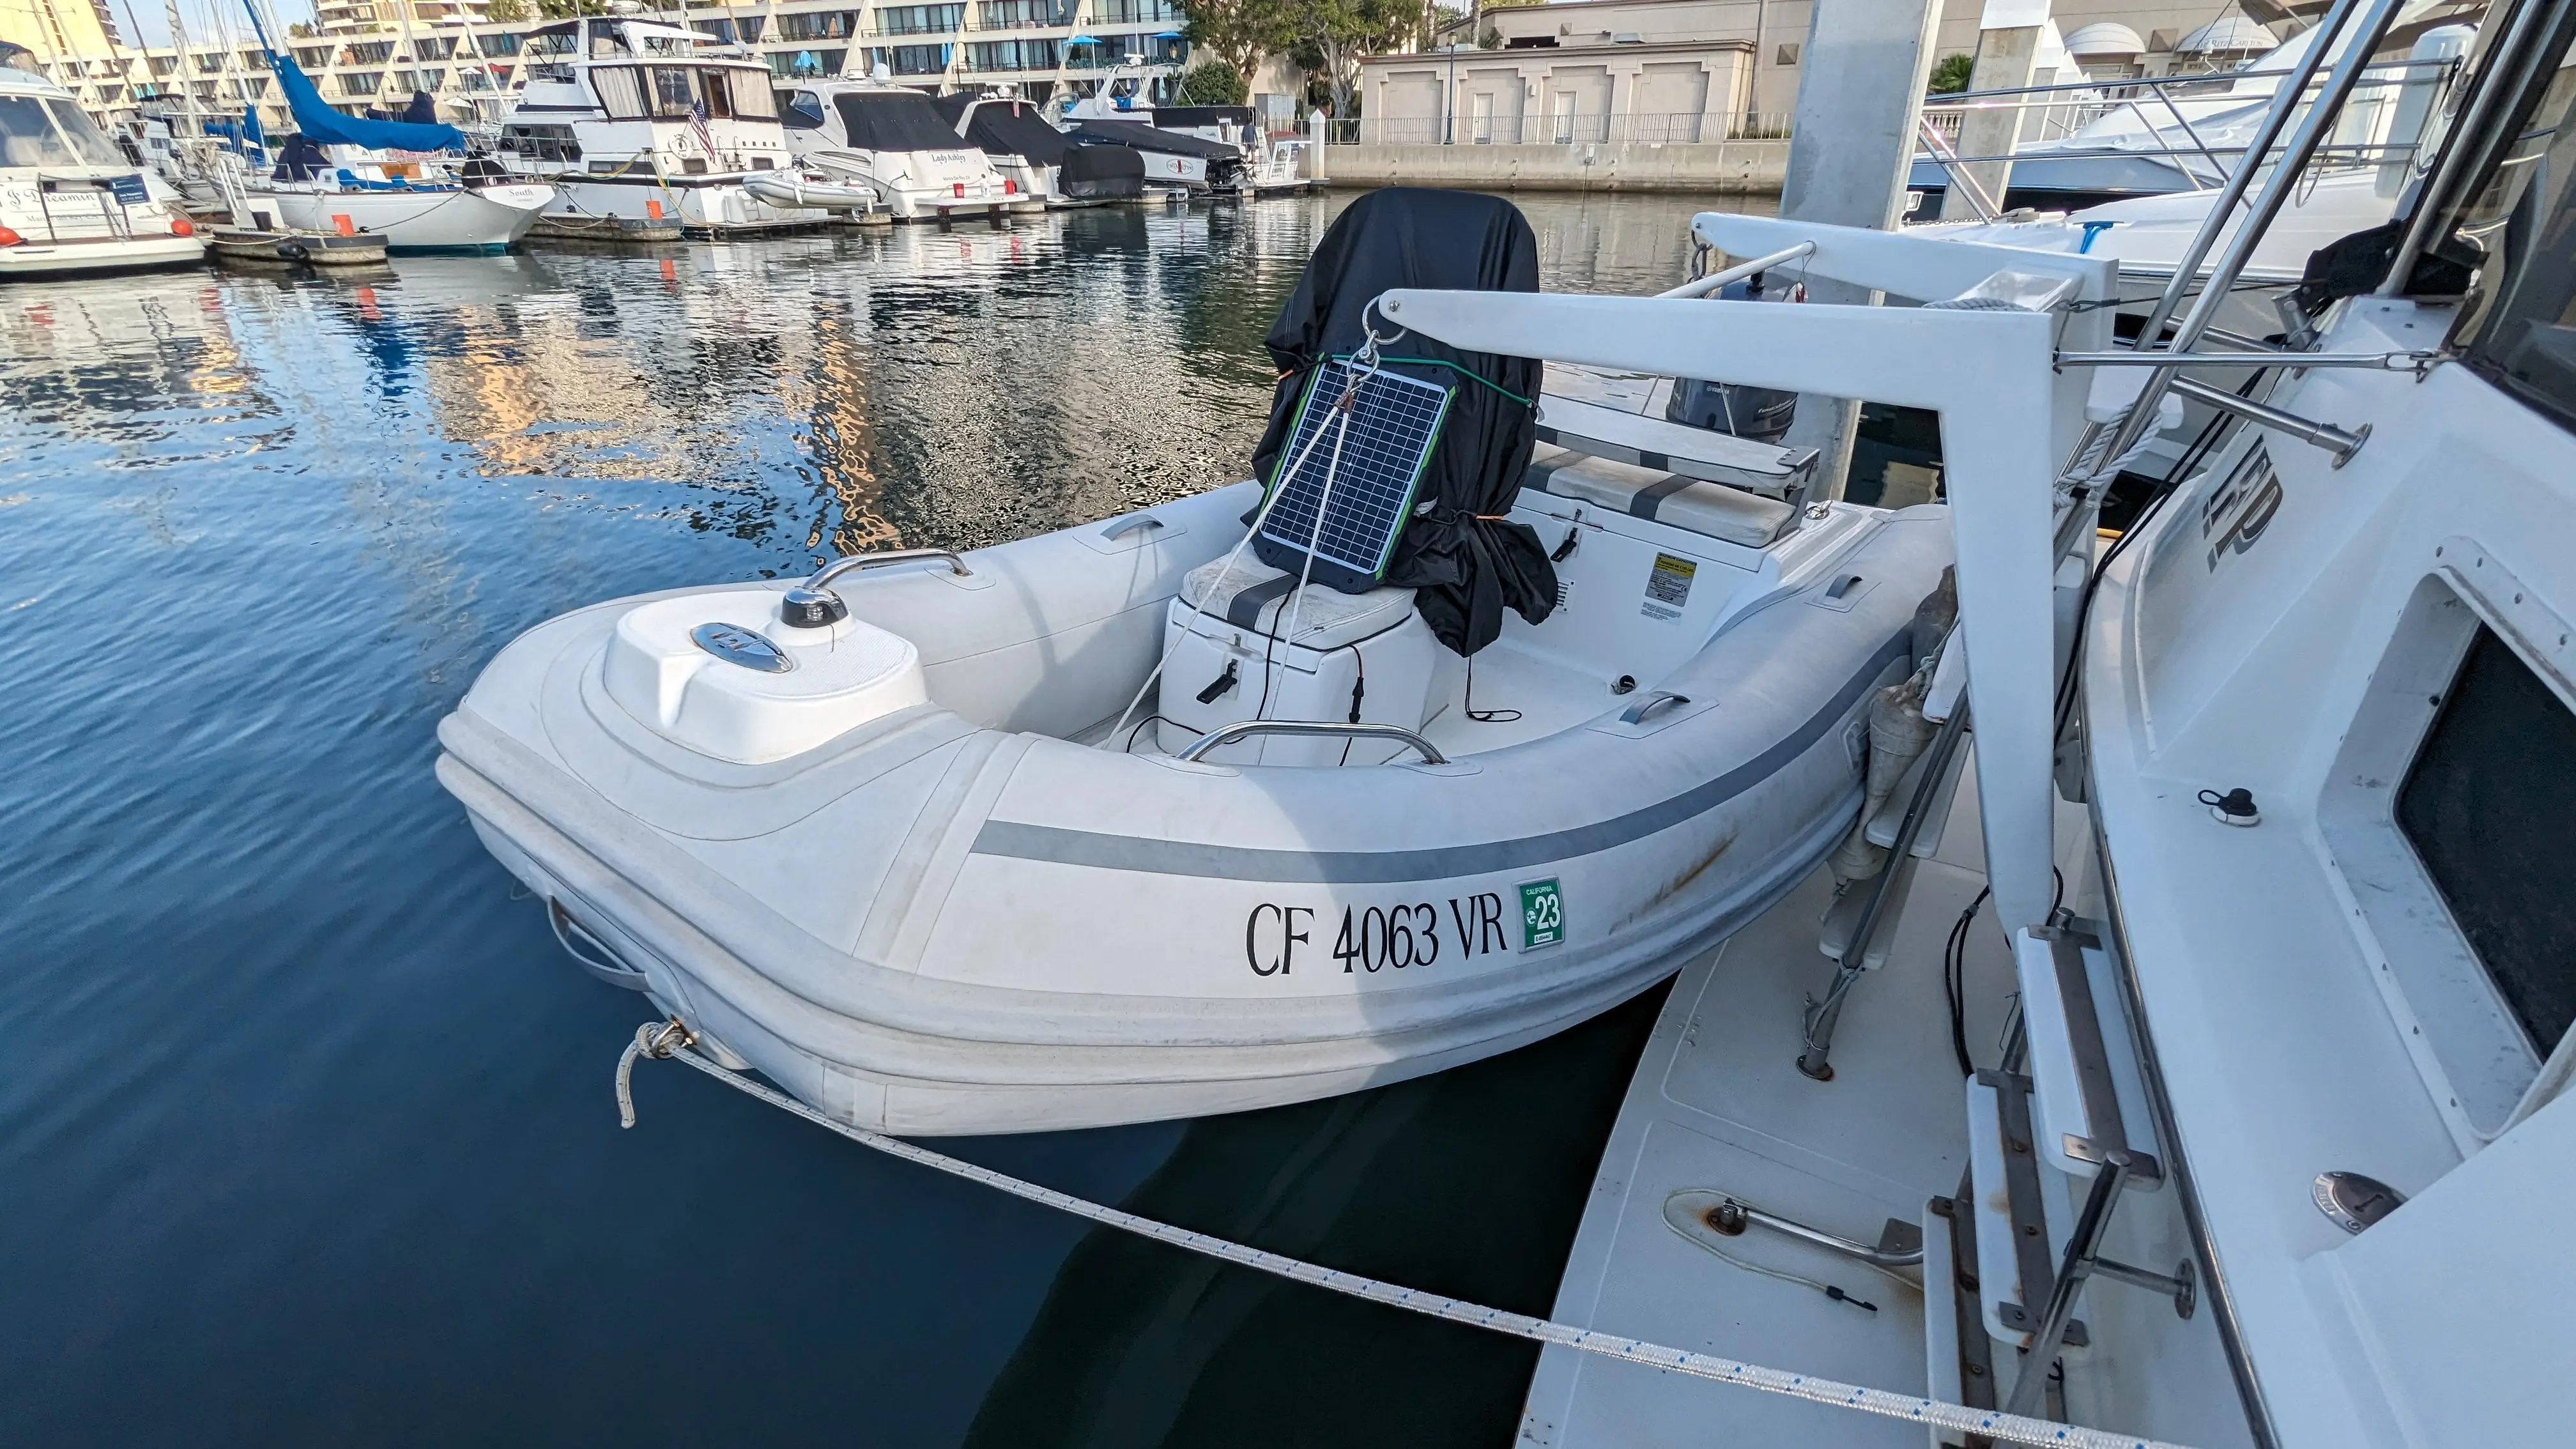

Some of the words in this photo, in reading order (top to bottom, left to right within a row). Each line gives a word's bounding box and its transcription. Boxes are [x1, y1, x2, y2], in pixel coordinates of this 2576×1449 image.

[1526, 885, 1552, 895] CALIFORNIA
[1535, 893, 1561, 930] 23
[1246, 903, 1315, 976] CF
[1332, 903, 1439, 974] 4063
[1448, 892, 1508, 961] VR
